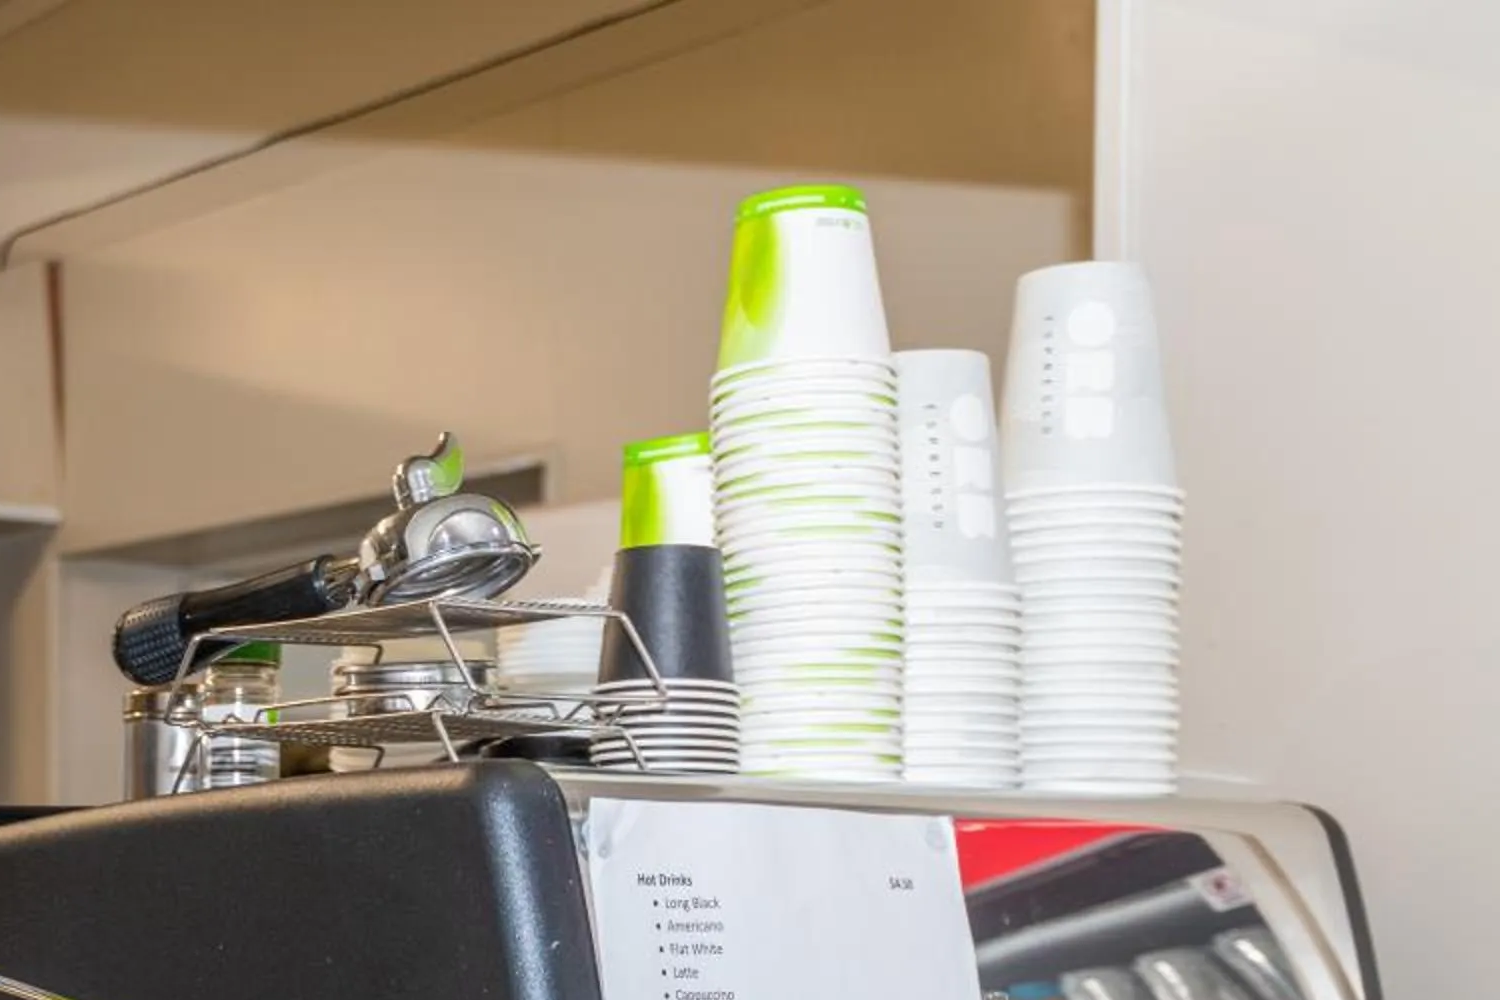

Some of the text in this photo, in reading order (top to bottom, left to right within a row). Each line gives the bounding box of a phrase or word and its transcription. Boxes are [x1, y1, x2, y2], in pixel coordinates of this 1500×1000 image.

[637, 873, 693, 888] Hot Drinks
[665, 896, 721, 912] Long Black
[667, 919, 724, 933] Americano
[669, 943, 724, 955] Flat White
[673, 967, 699, 979] Latte
